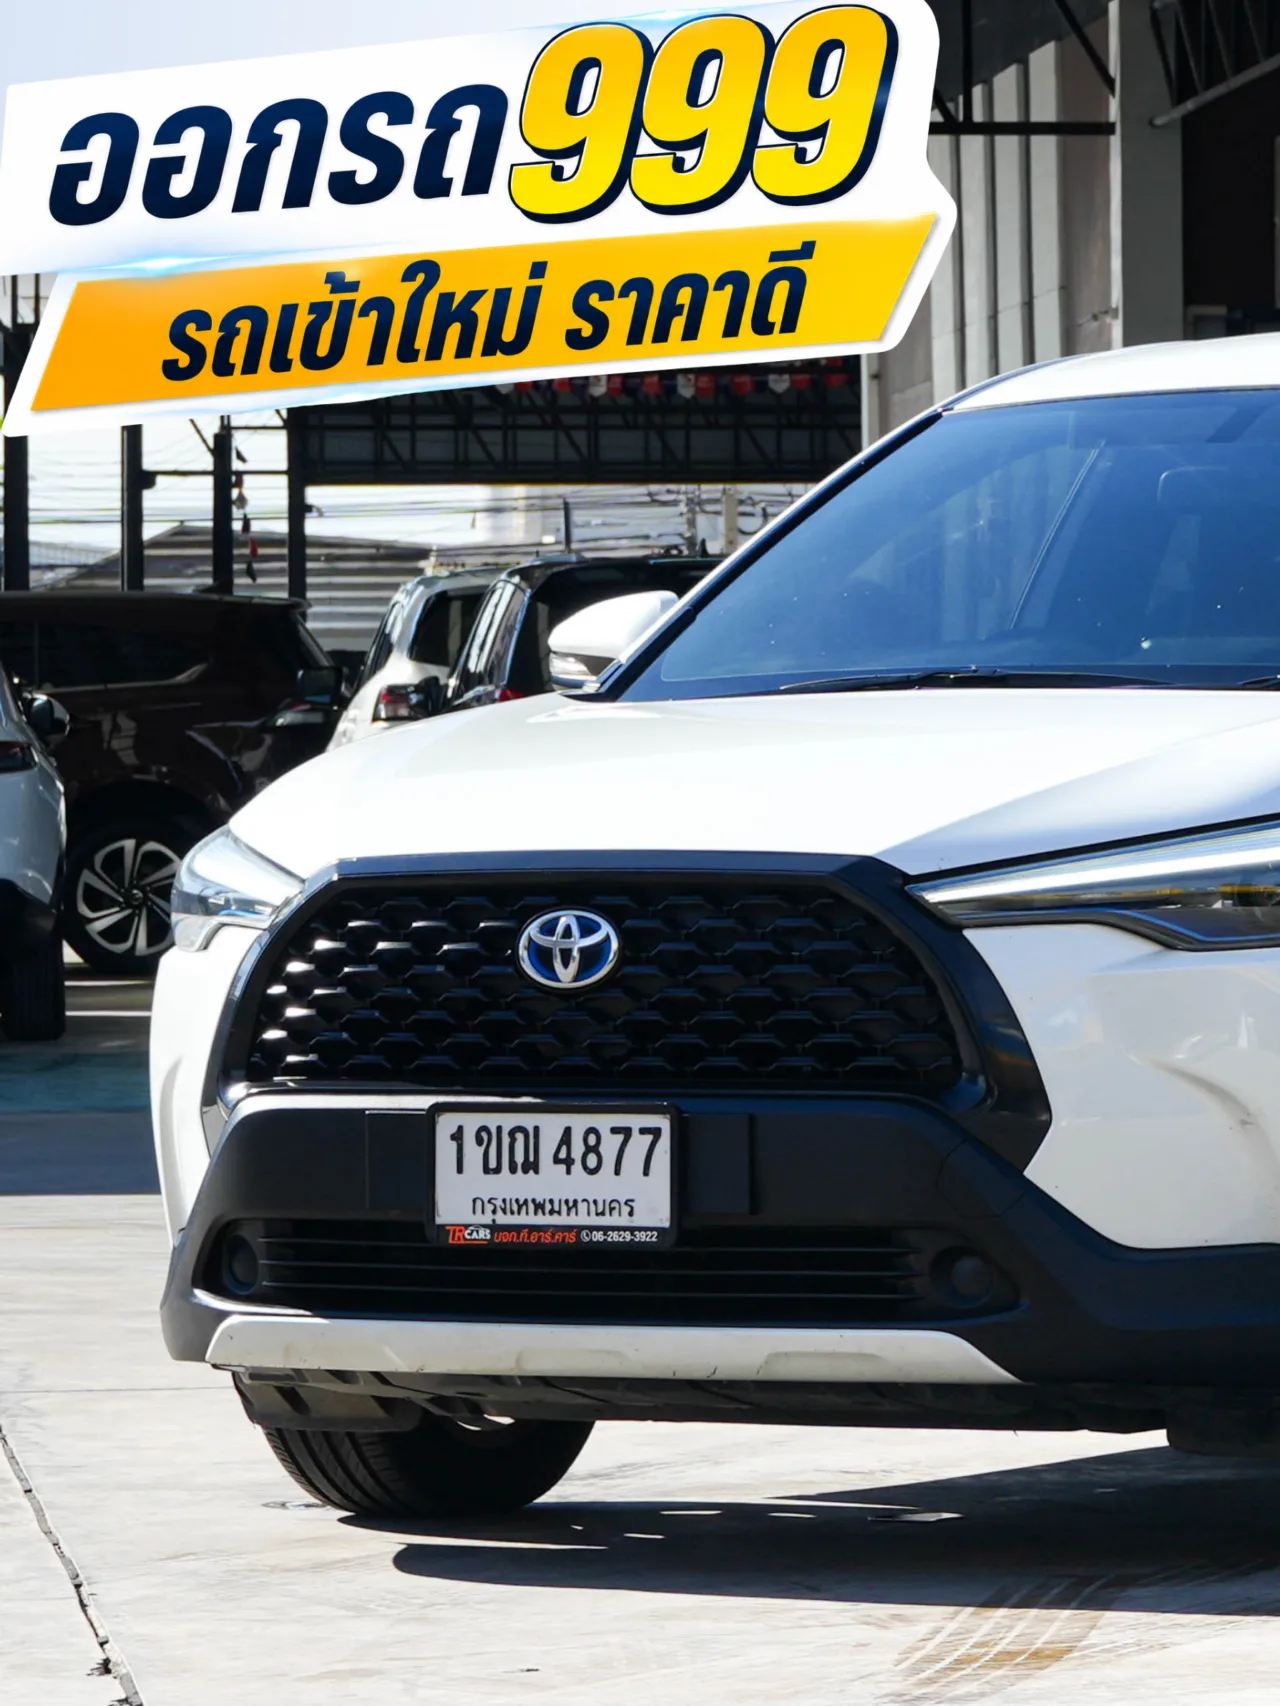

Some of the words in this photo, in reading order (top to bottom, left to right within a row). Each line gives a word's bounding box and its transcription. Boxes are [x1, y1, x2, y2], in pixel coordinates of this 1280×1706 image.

[552, 1125, 663, 1177] 4877
[471, 1196, 636, 1225] กรุงเทพมหานคร
[464, 1227, 491, 1241] CARS
[591, 1230, 659, 1243] 06-2629-3922
